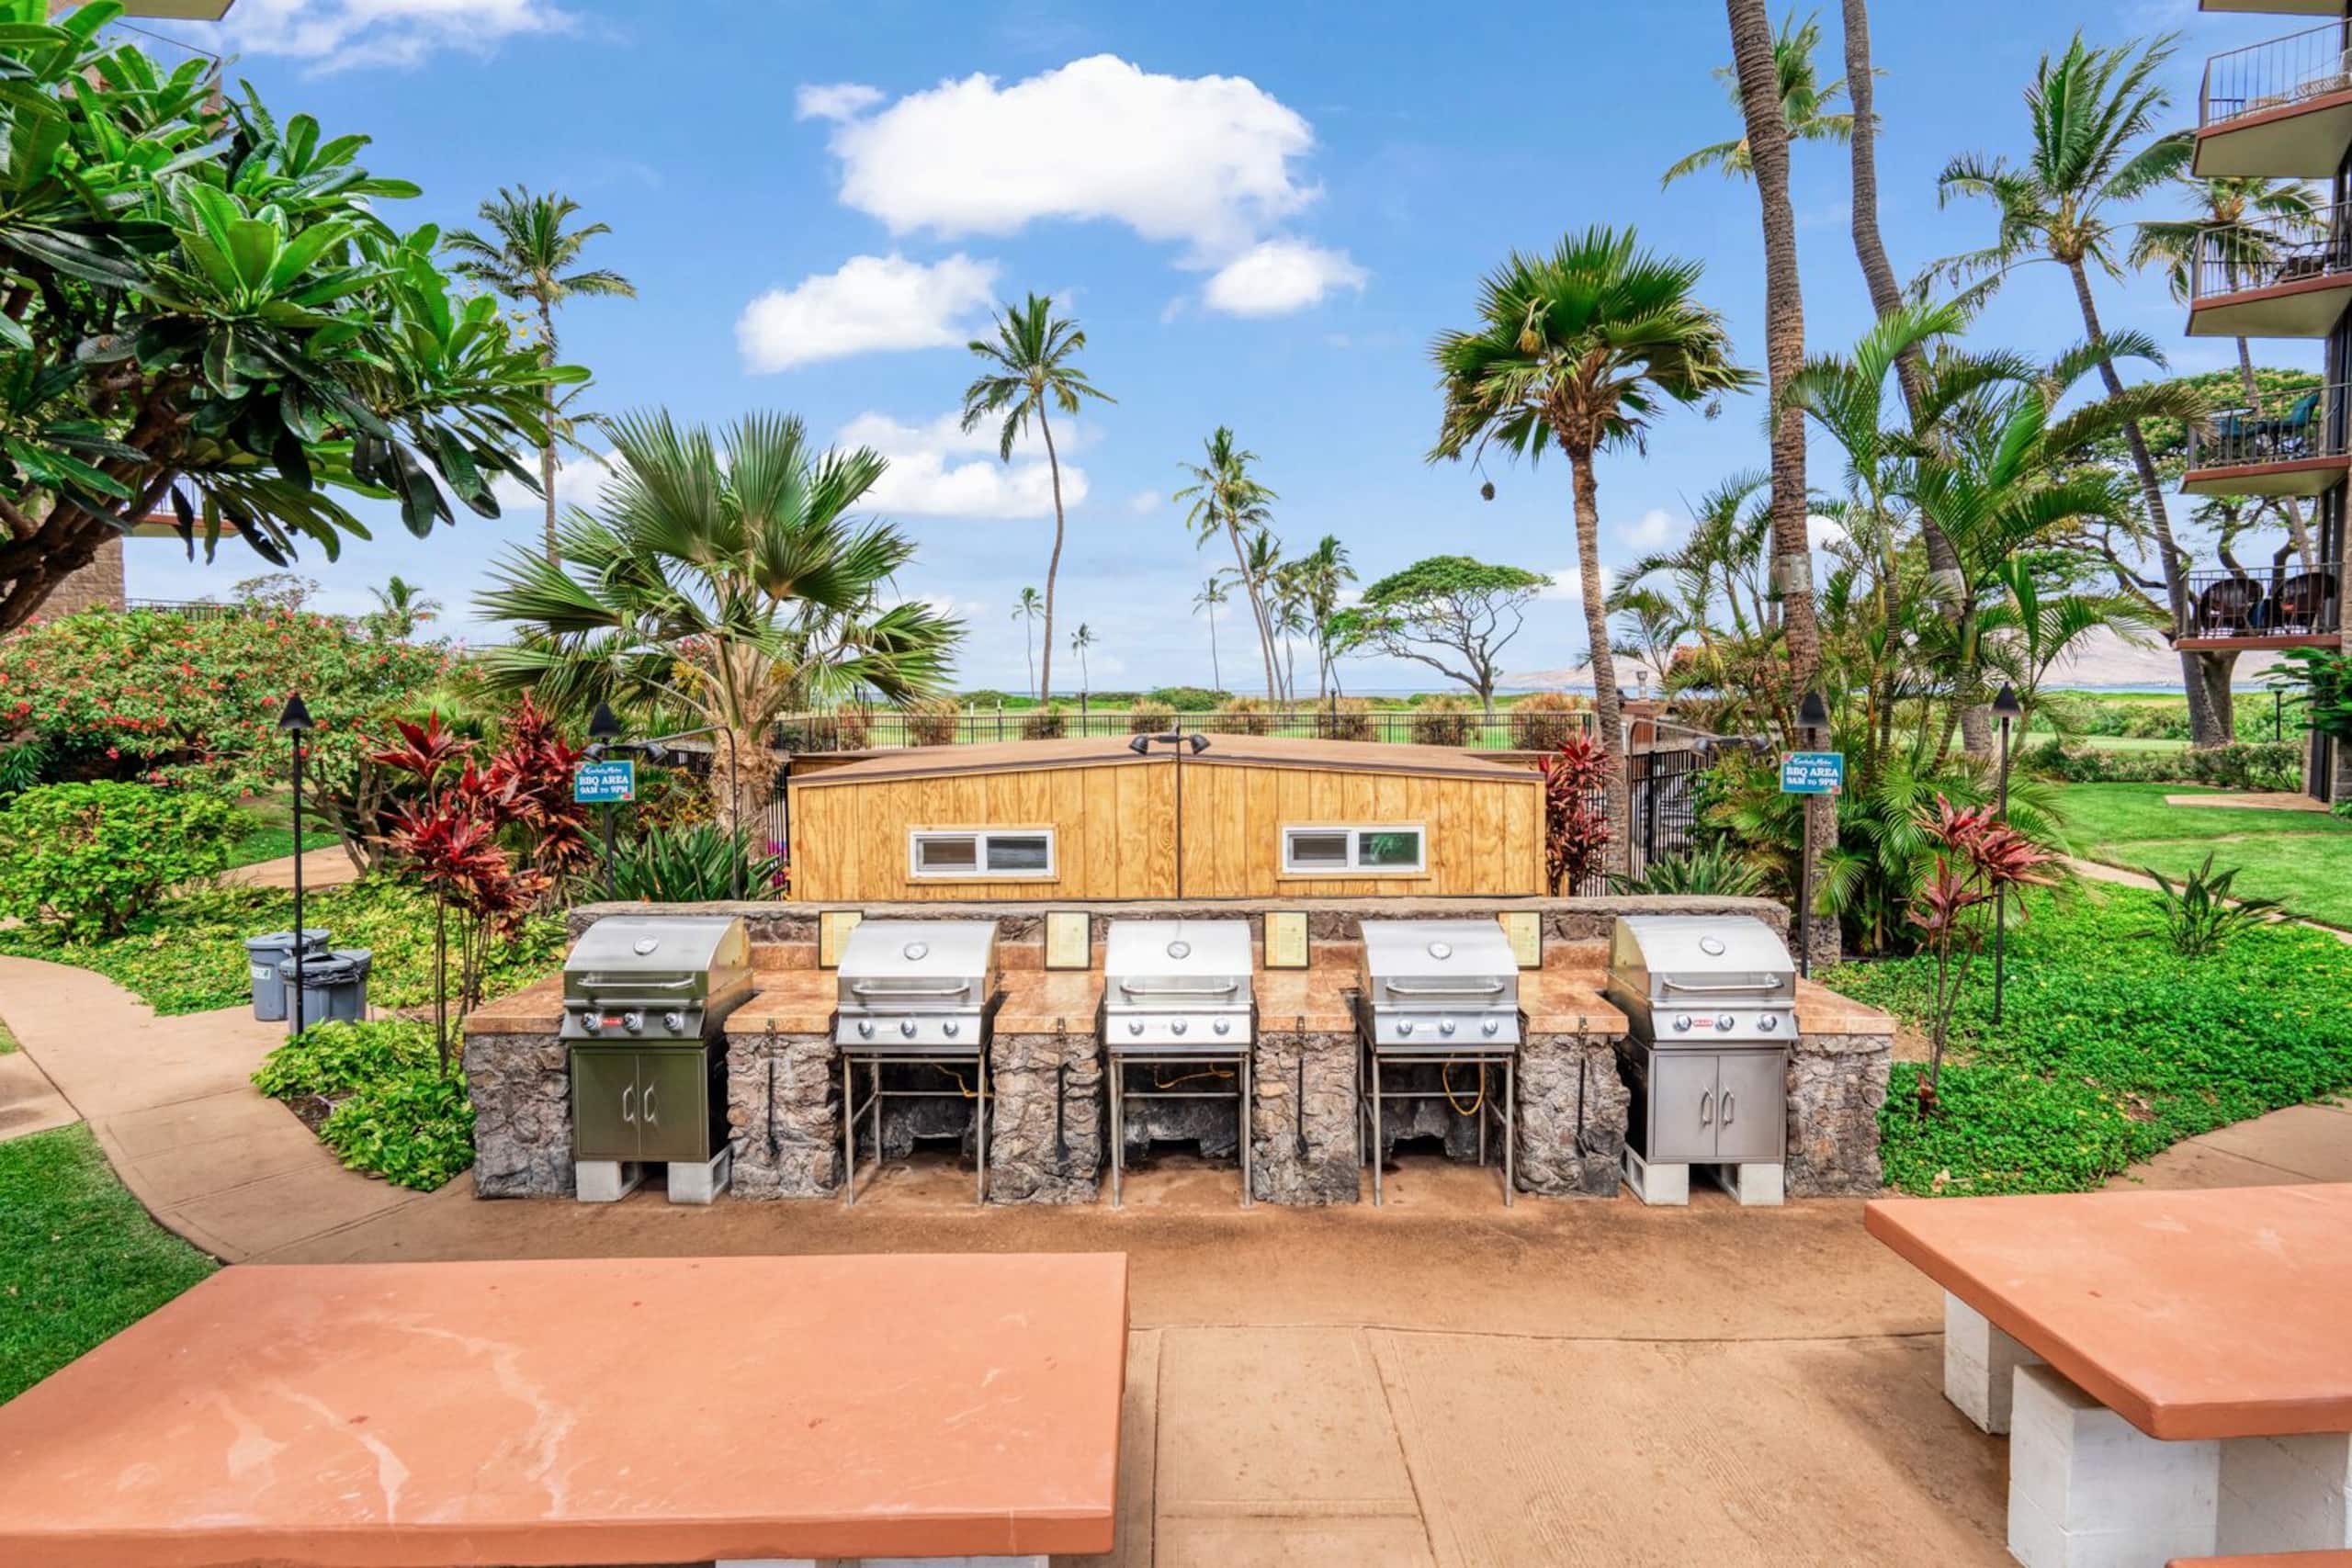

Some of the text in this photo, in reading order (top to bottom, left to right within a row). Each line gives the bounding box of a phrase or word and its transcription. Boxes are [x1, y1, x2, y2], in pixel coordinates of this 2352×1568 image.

[1786, 767, 1838, 778] BBQ AREA
[579, 775, 628, 785] BBQ AREA
